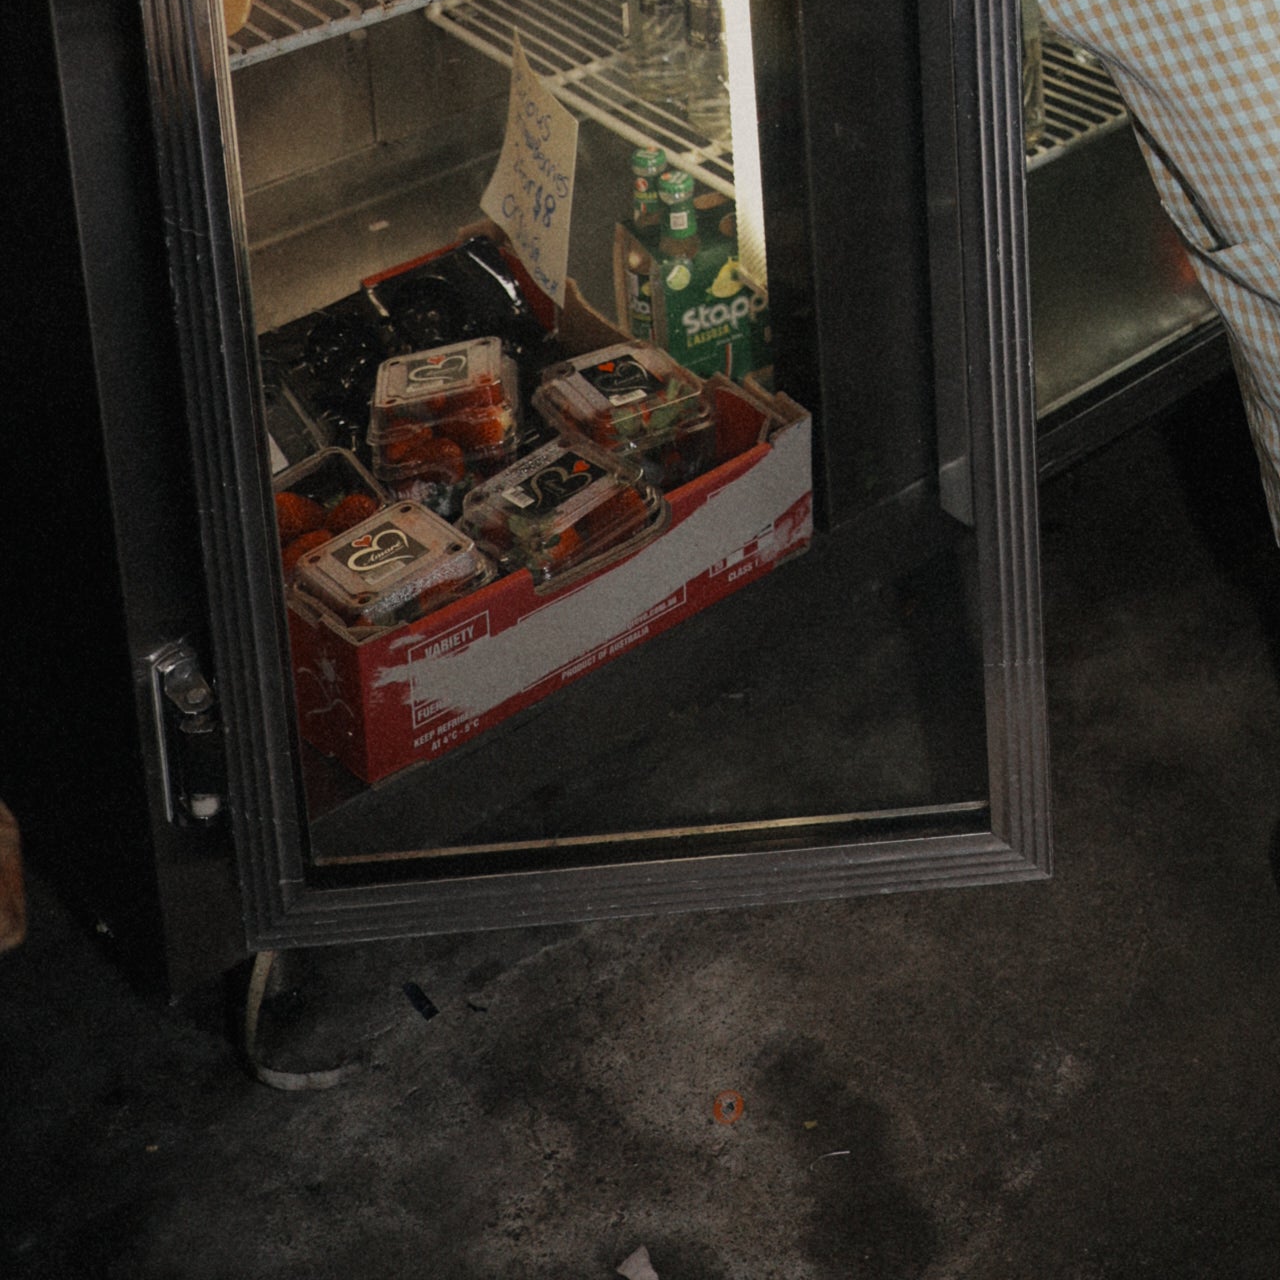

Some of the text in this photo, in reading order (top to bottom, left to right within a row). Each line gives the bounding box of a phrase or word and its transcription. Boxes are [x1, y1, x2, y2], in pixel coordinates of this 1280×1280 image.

[728, 563, 753, 583] CLASS
[423, 626, 475, 660] VARIETY
[561, 625, 650, 681] PRODUCT OF AUSTRALIA
[413, 730, 436, 749] KEEP
[431, 739, 441, 751] AT
